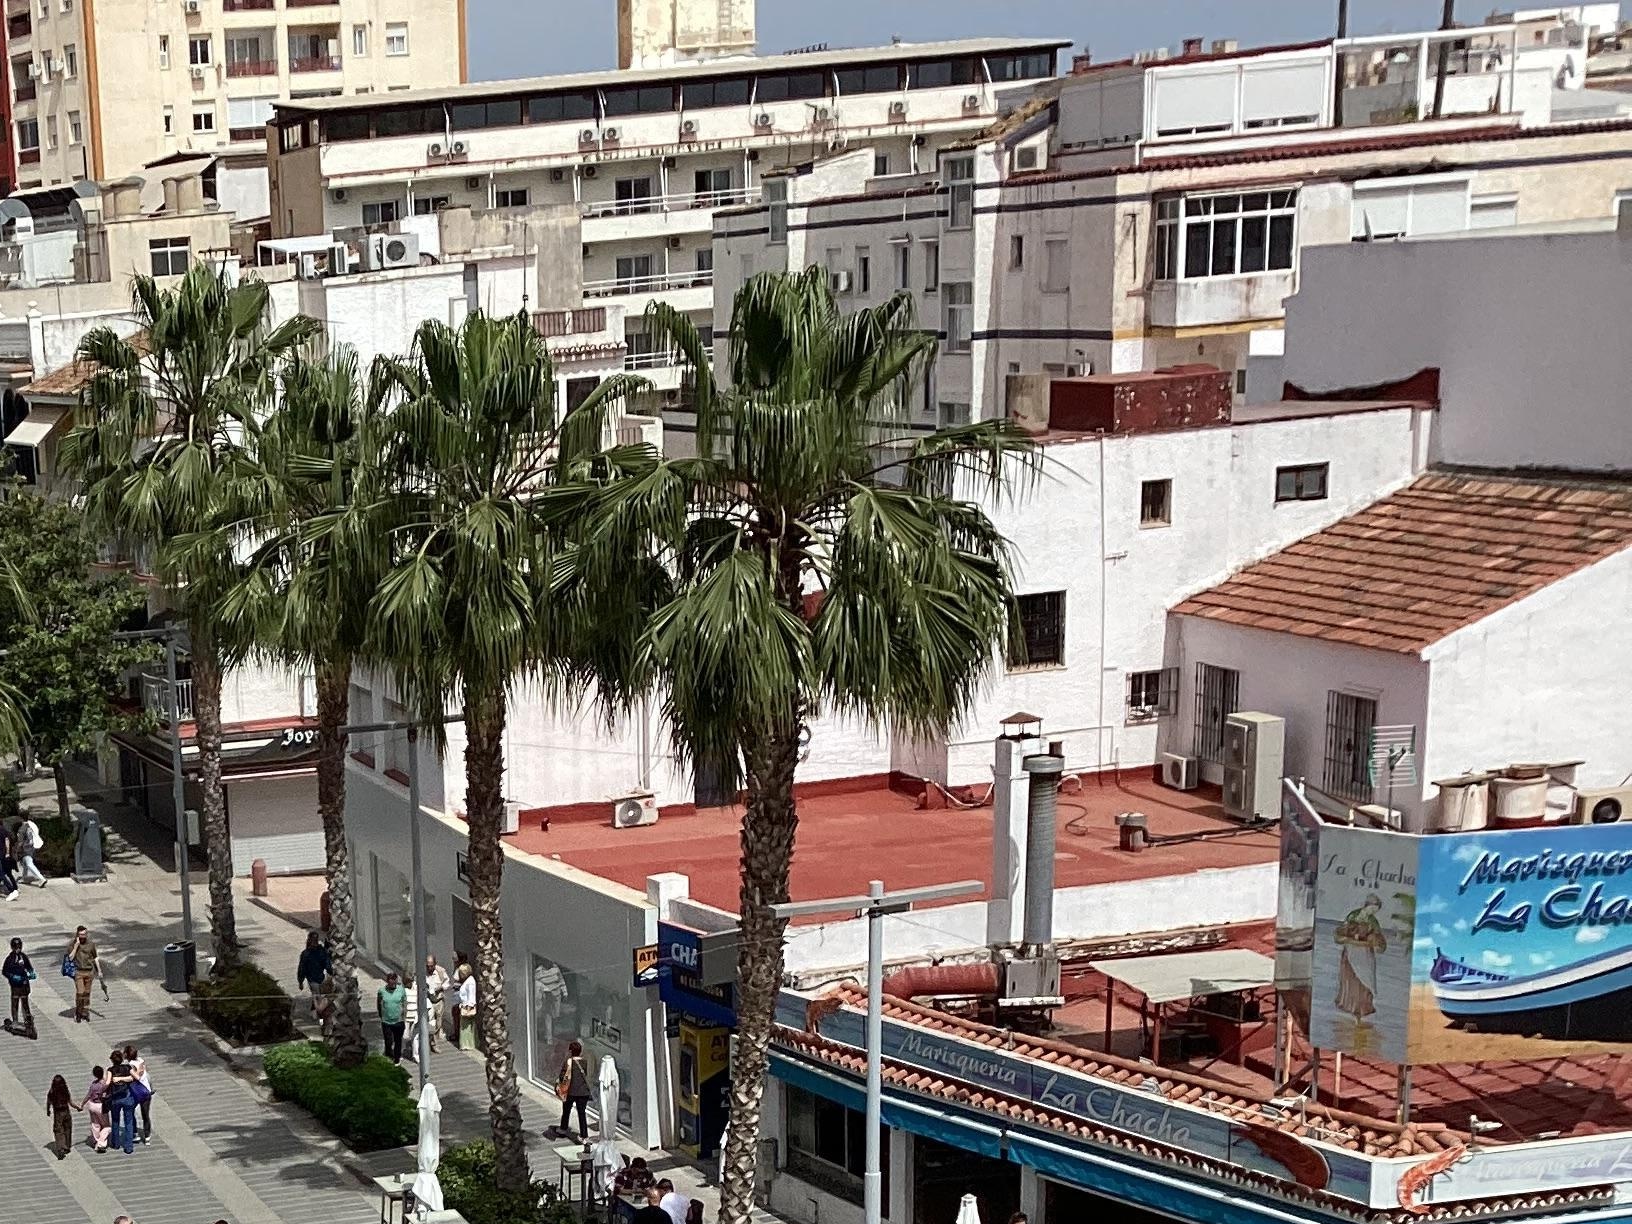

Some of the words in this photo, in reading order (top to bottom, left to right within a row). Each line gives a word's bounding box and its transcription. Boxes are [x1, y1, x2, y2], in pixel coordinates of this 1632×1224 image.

[281, 728, 319, 746] Joy
[1471, 887, 1533, 935] La
[1039, 1074, 1077, 1112] La
[1086, 1088, 1194, 1145] Chacha
